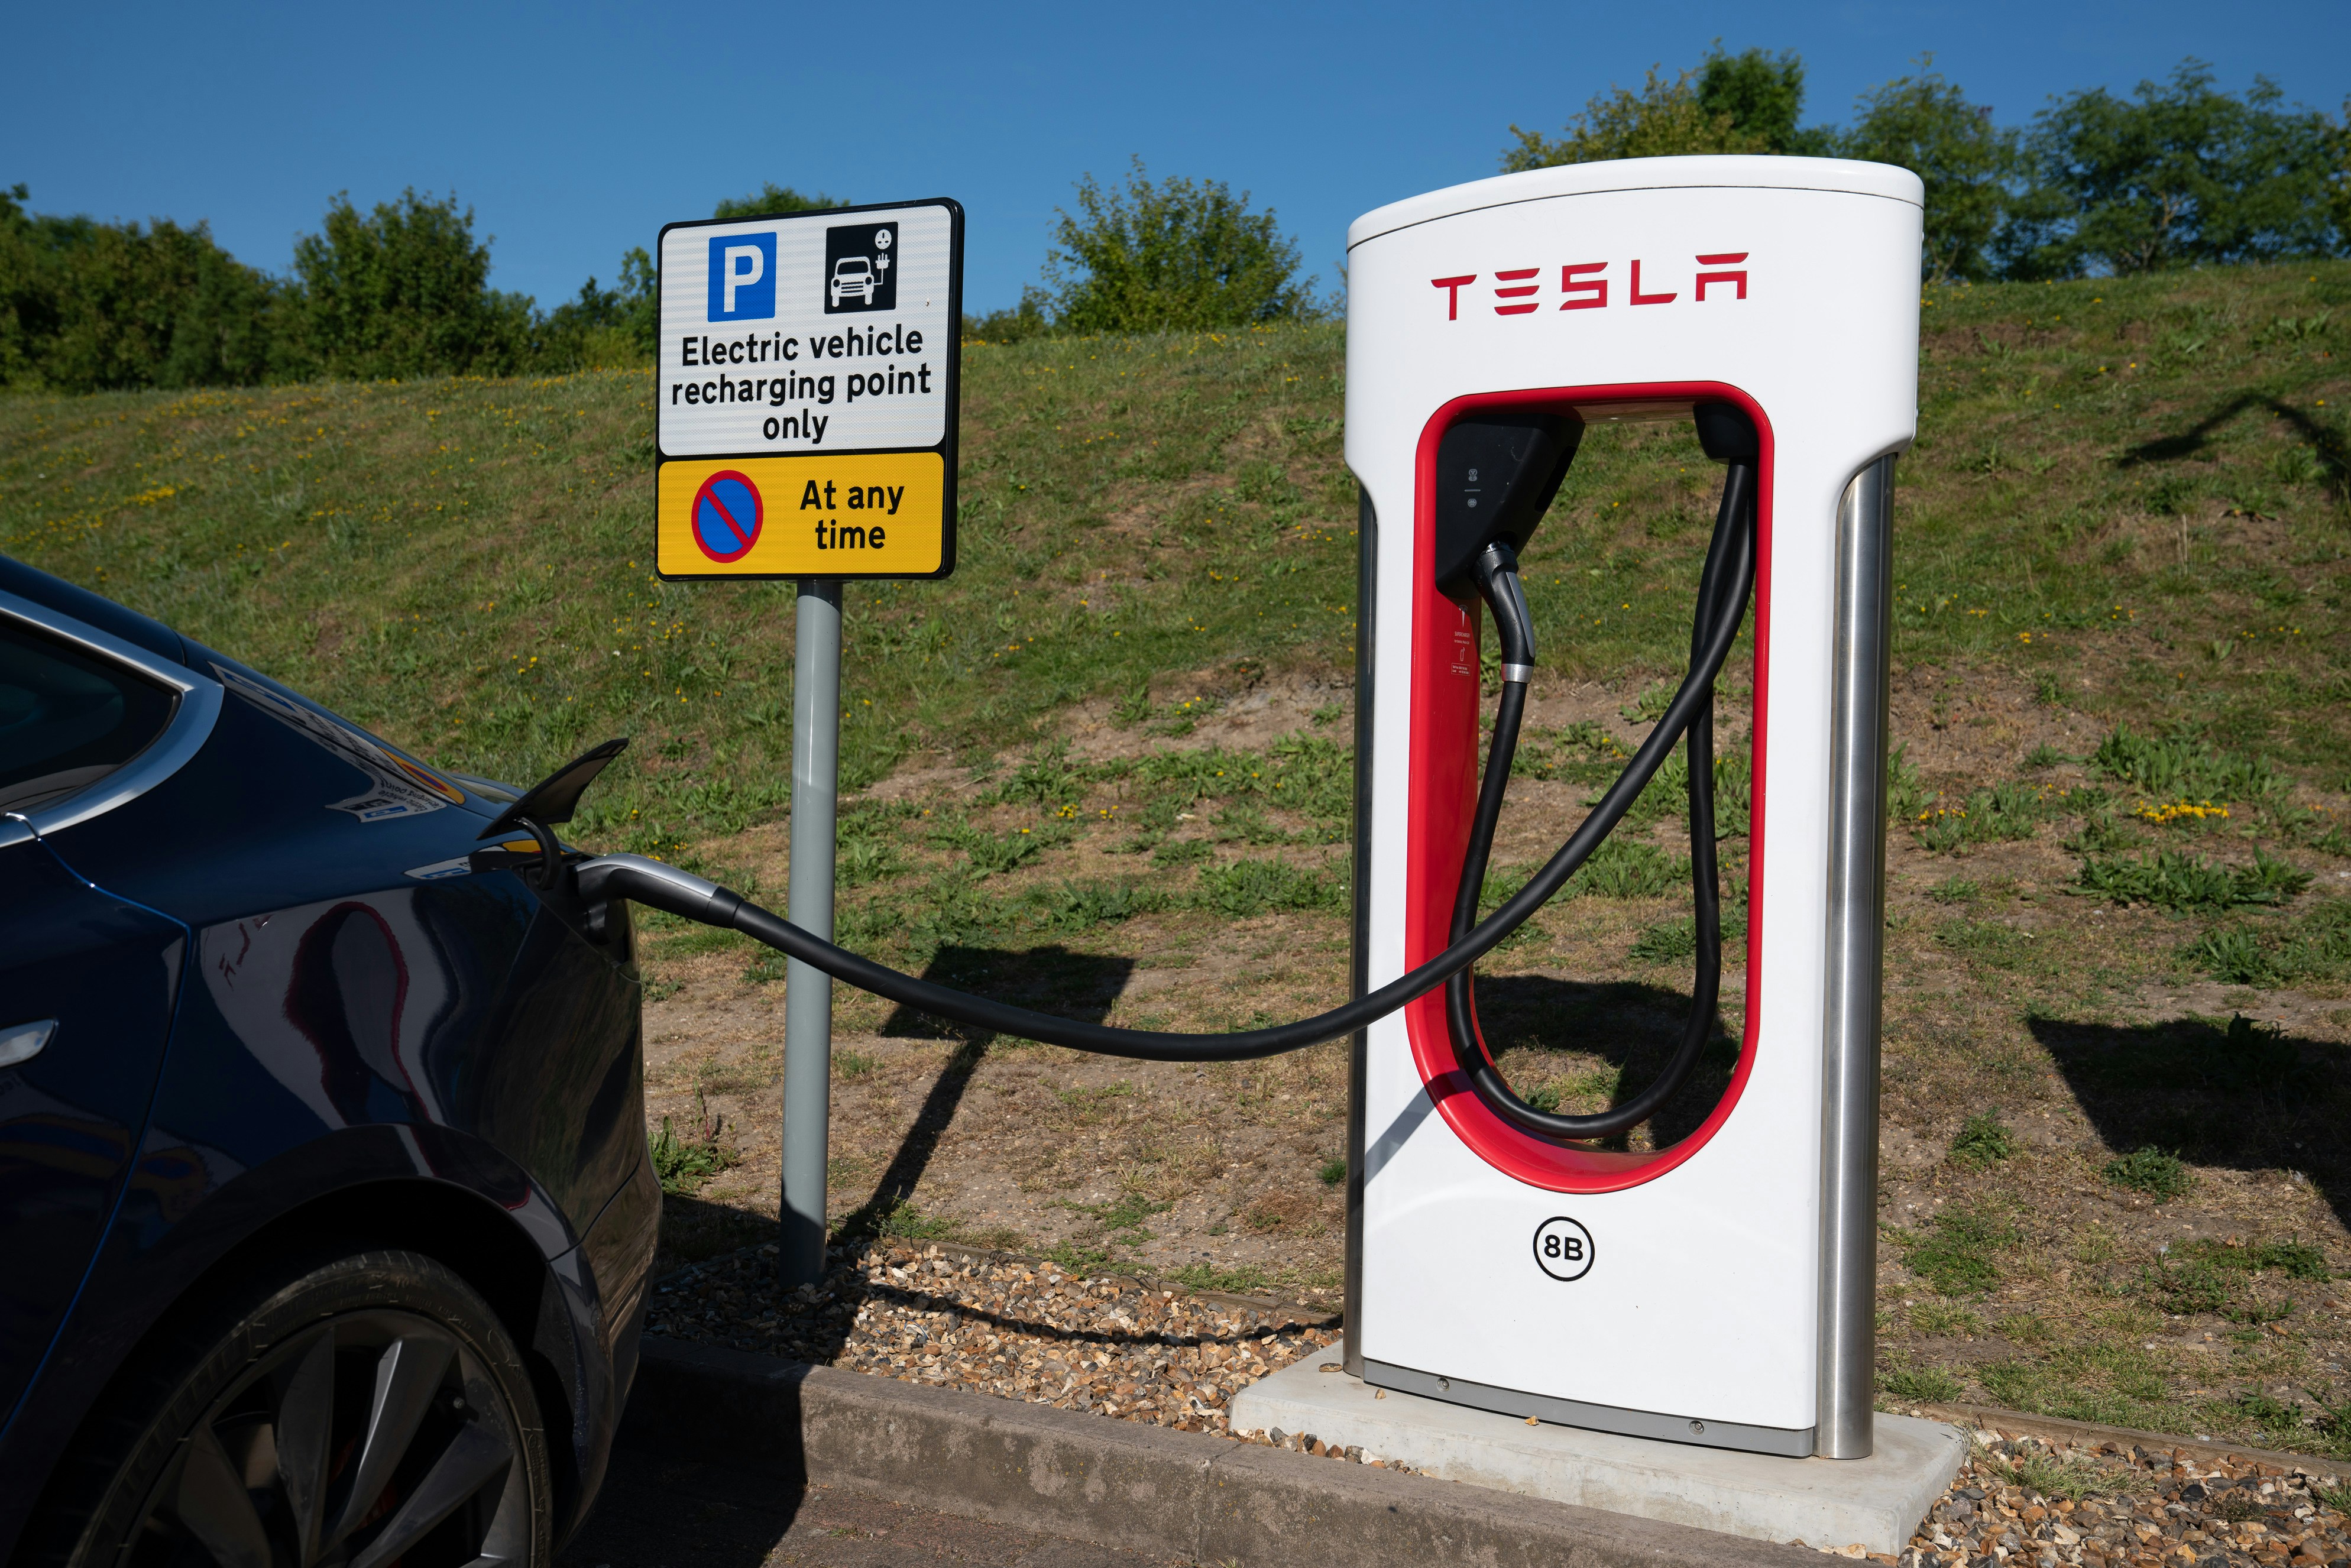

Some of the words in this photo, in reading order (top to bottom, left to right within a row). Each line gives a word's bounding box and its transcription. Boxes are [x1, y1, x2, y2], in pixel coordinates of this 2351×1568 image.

[724, 245, 764, 313] P
[1431, 252, 1749, 321] TESLA
[682, 331, 799, 367] Electric
[809, 323, 923, 359] vehicle
[672, 369, 835, 407] recharging
[847, 362, 931, 403] point
[763, 408, 829, 445] only
[799, 480, 837, 510] At
[847, 486, 905, 515] any
[815, 519, 886, 550] time
[1544, 1234, 1583, 1261] 8B
